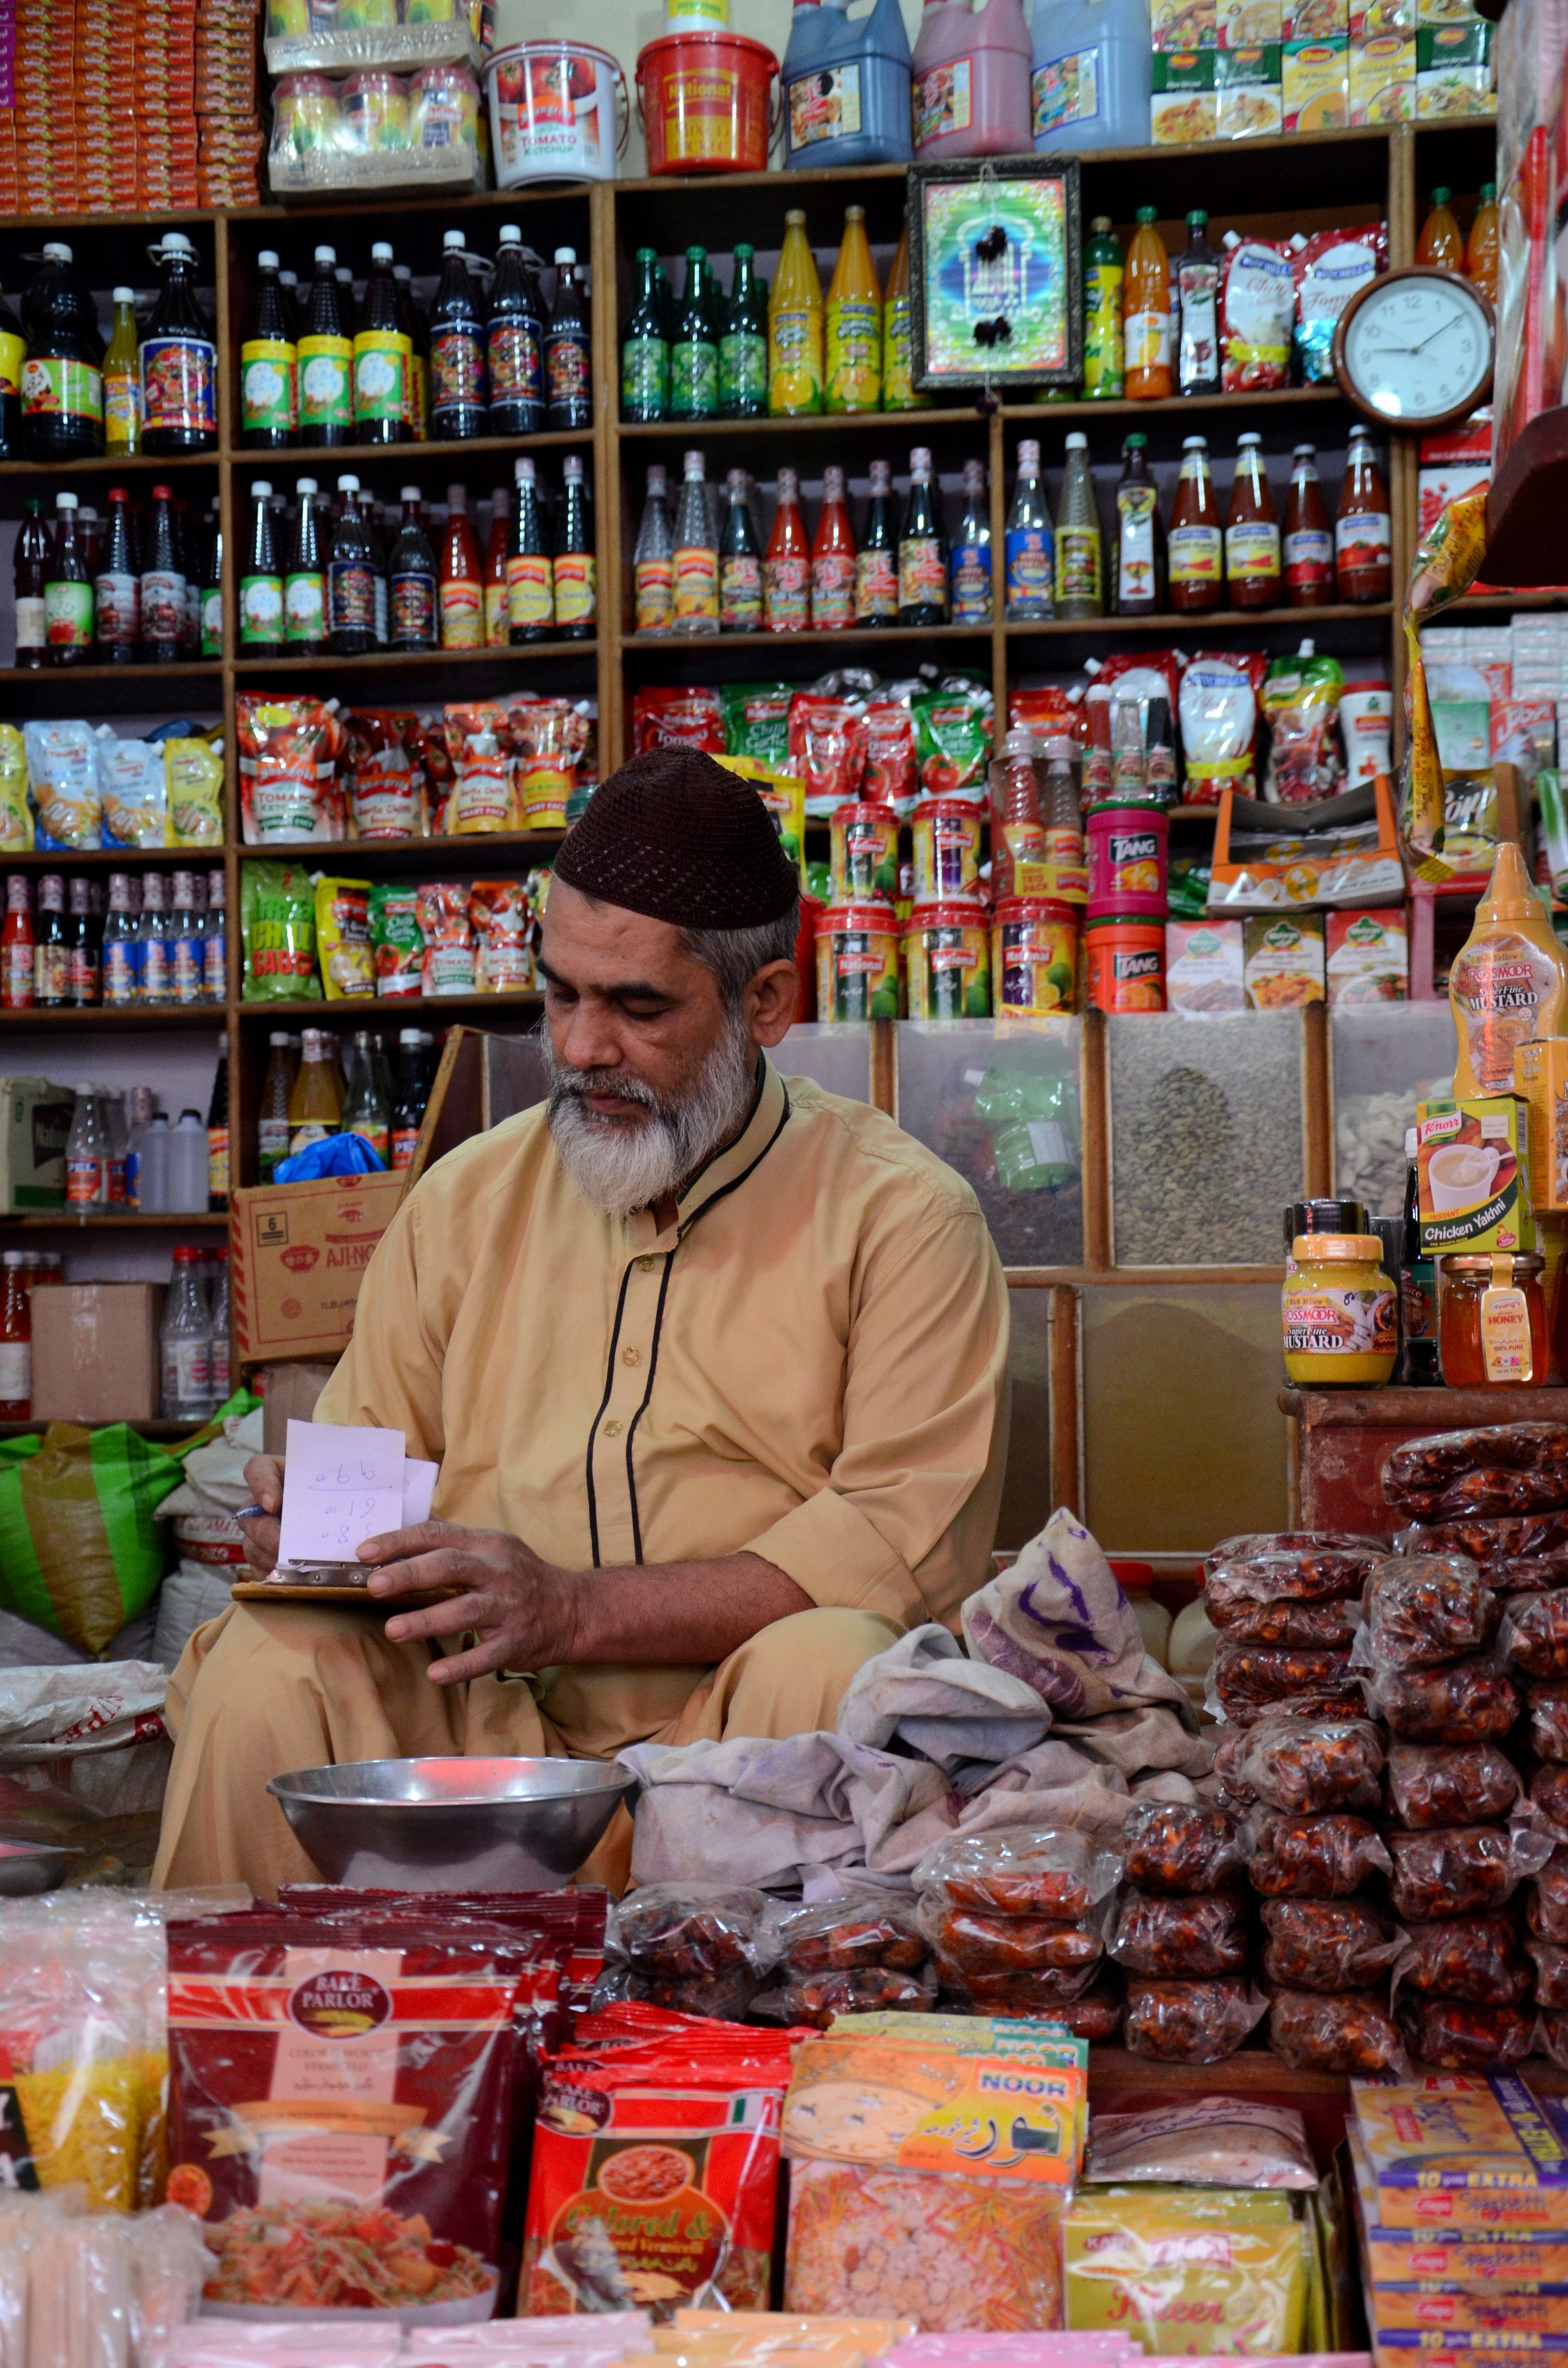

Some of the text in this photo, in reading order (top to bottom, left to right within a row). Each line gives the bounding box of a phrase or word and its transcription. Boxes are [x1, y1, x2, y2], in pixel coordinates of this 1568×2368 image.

[1404, 295, 1421, 309] 12
[1365, 323, 1382, 338] 10
[1462, 339, 1472, 353] 3
[1360, 349, 1371, 364] 9
[849, 839, 885, 853] National
[938, 836, 973, 849] National
[1113, 839, 1156, 862] TANG
[931, 953, 977, 969] National
[1005, 950, 1051, 964] National
[1494, 953, 1518, 962] Yellow
[840, 961, 883, 974] National
[1117, 956, 1158, 978] TANG
[1469, 964, 1533, 980] ROSSMOOR
[1469, 991, 1539, 1011] MUSTARD
[1424, 1118, 1459, 1136] Knorr
[1424, 1197, 1507, 1241] Chicken Yakhni
[1429, 1209, 1460, 1221] INSTANT
[268, 1217, 276, 1231] 6
[1494, 1300, 1521, 1311] Young's
[1488, 1315, 1524, 1325] HONEY
[1288, 1326, 1327, 1336] SuperFine
[316, 1974, 360, 1991] BAKE
[302, 1991, 374, 2008] PARLOR
[980, 2071, 1067, 2097] NOOR
[1417, 2171, 1441, 2188] 10
[1468, 2171, 1539, 2188] EXTRA
[686, 2212, 711, 2240] &
[1421, 2332, 1444, 2348] 10
[1472, 2333, 1542, 2349] EXTRA
